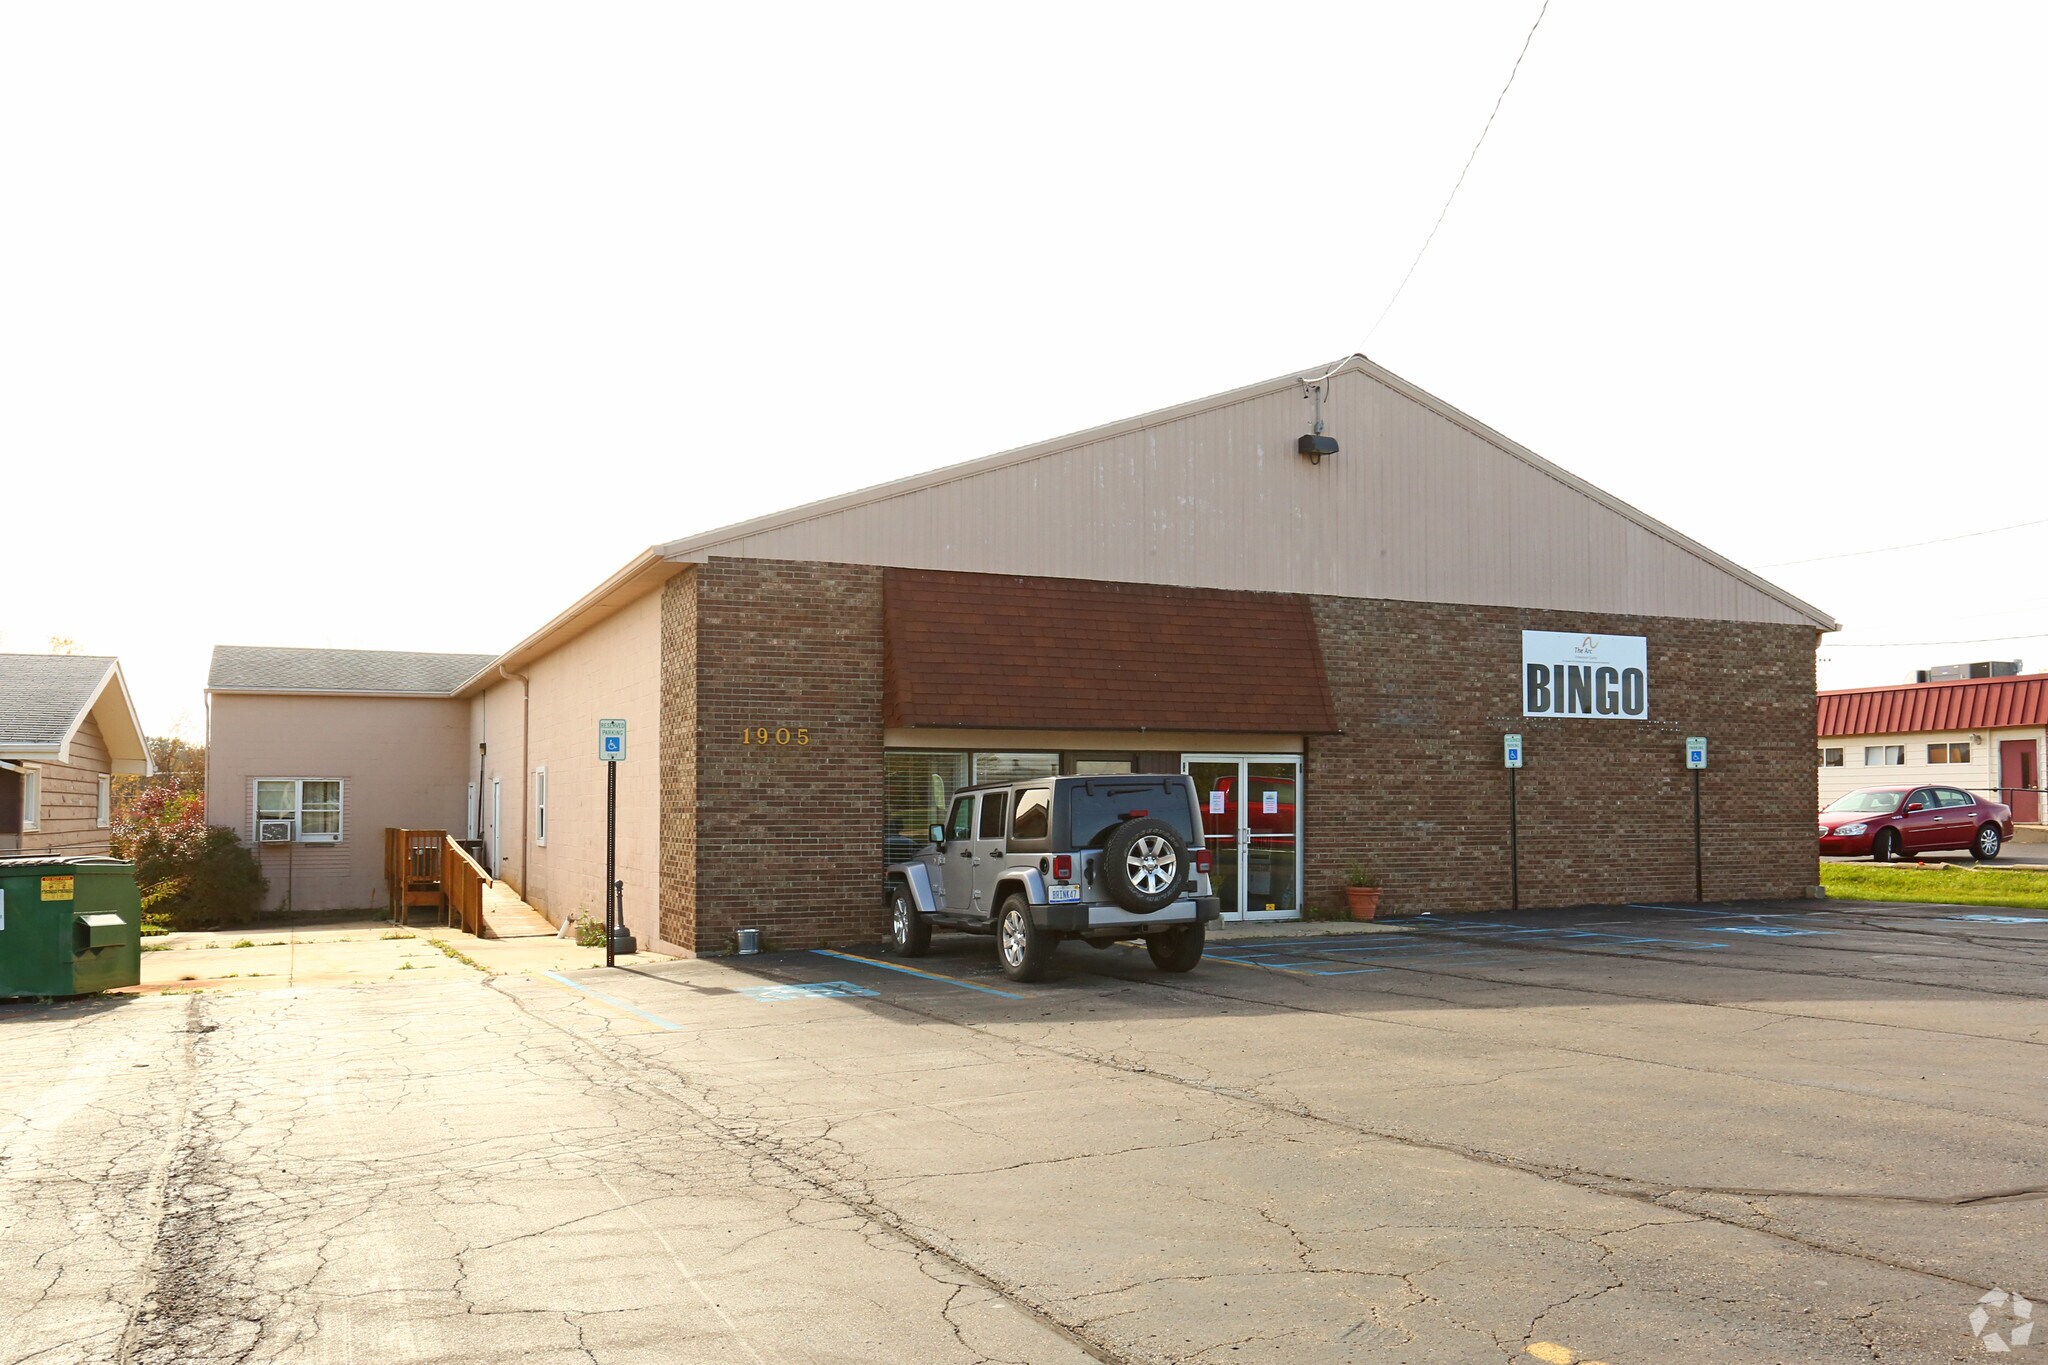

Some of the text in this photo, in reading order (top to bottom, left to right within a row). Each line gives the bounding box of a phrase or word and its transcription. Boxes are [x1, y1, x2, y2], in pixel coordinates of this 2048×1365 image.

[1574, 646, 1583, 654] The
[1526, 663, 1644, 715] BINGO
[743, 727, 809, 745] 1905
[1052, 889, 1077, 900] BRINK47
